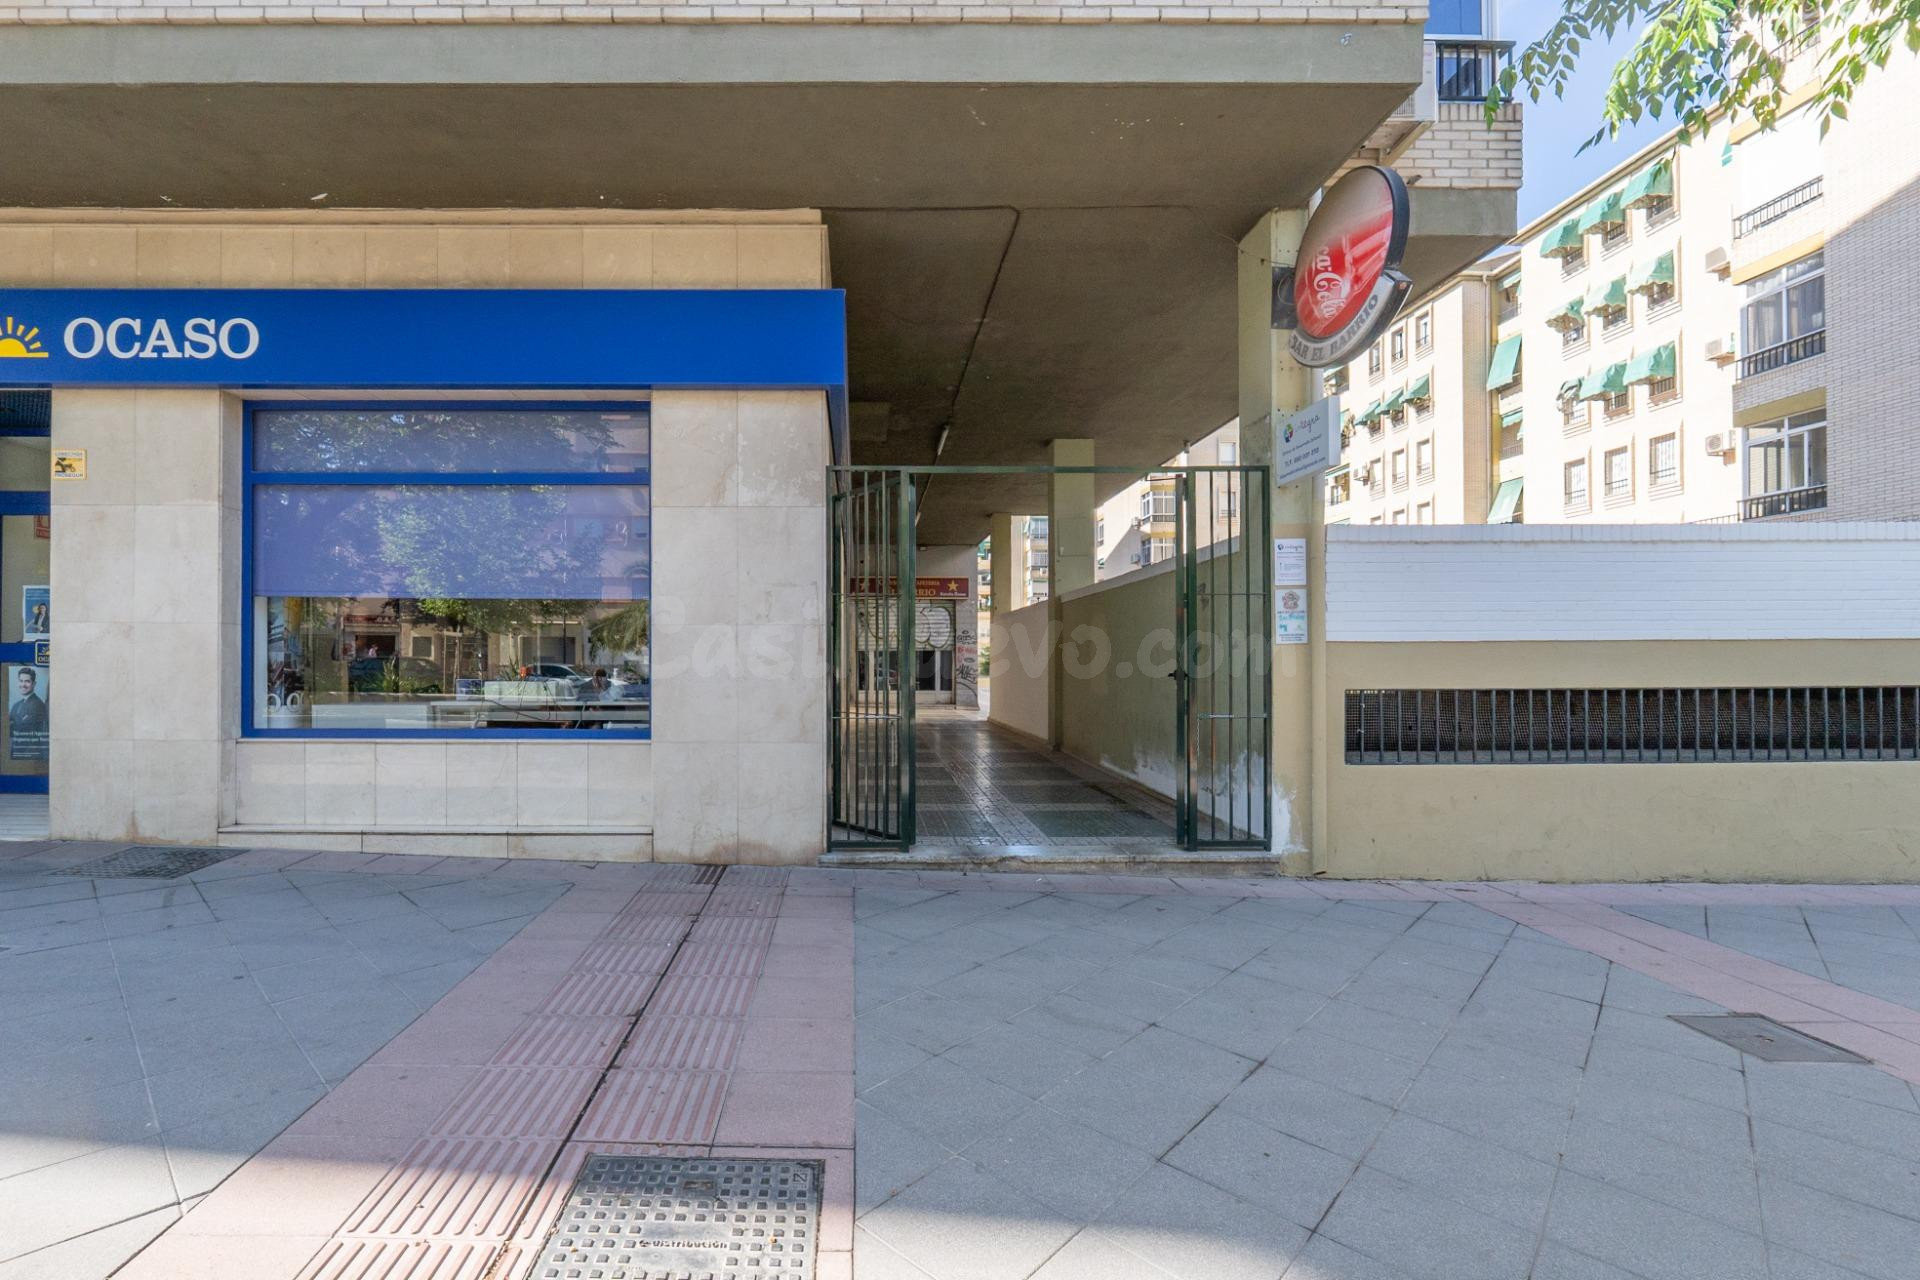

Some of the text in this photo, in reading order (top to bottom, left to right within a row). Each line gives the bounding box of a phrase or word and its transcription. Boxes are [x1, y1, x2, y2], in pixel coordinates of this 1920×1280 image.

[63, 316, 260, 359] OCASO
[1290, 294, 1378, 361] BAR EL BARRIO
